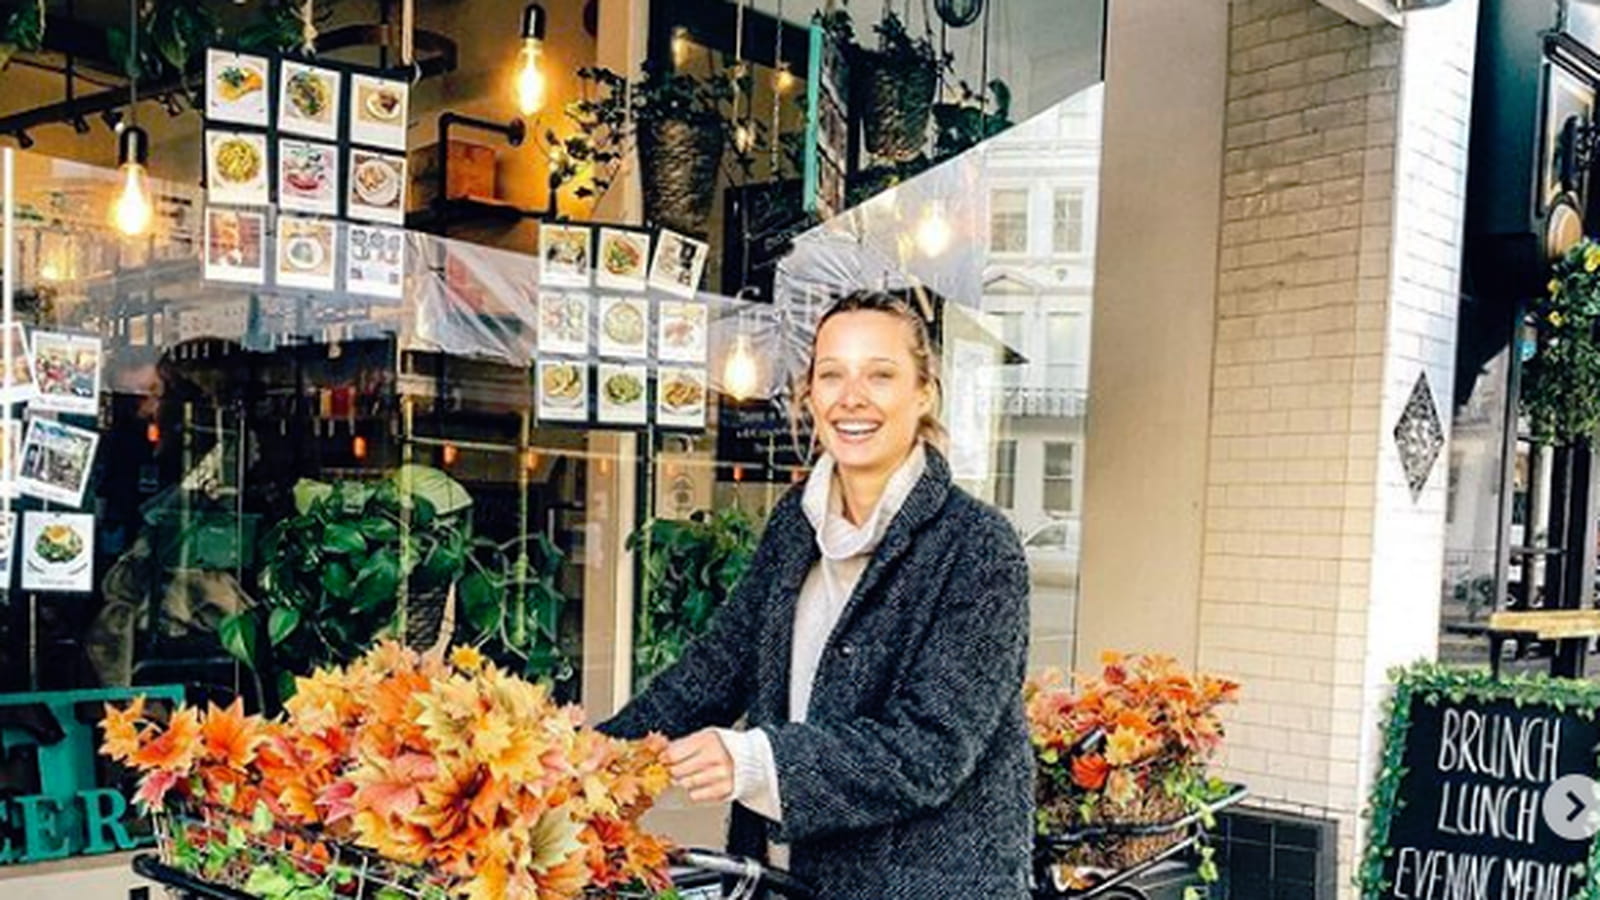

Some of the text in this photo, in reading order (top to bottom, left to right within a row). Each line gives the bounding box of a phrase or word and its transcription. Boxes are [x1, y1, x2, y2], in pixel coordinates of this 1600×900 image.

[1437, 707, 1561, 783] BRUNCH
[0, 787, 137, 865] ER
[1437, 780, 1540, 844] LUNCH
